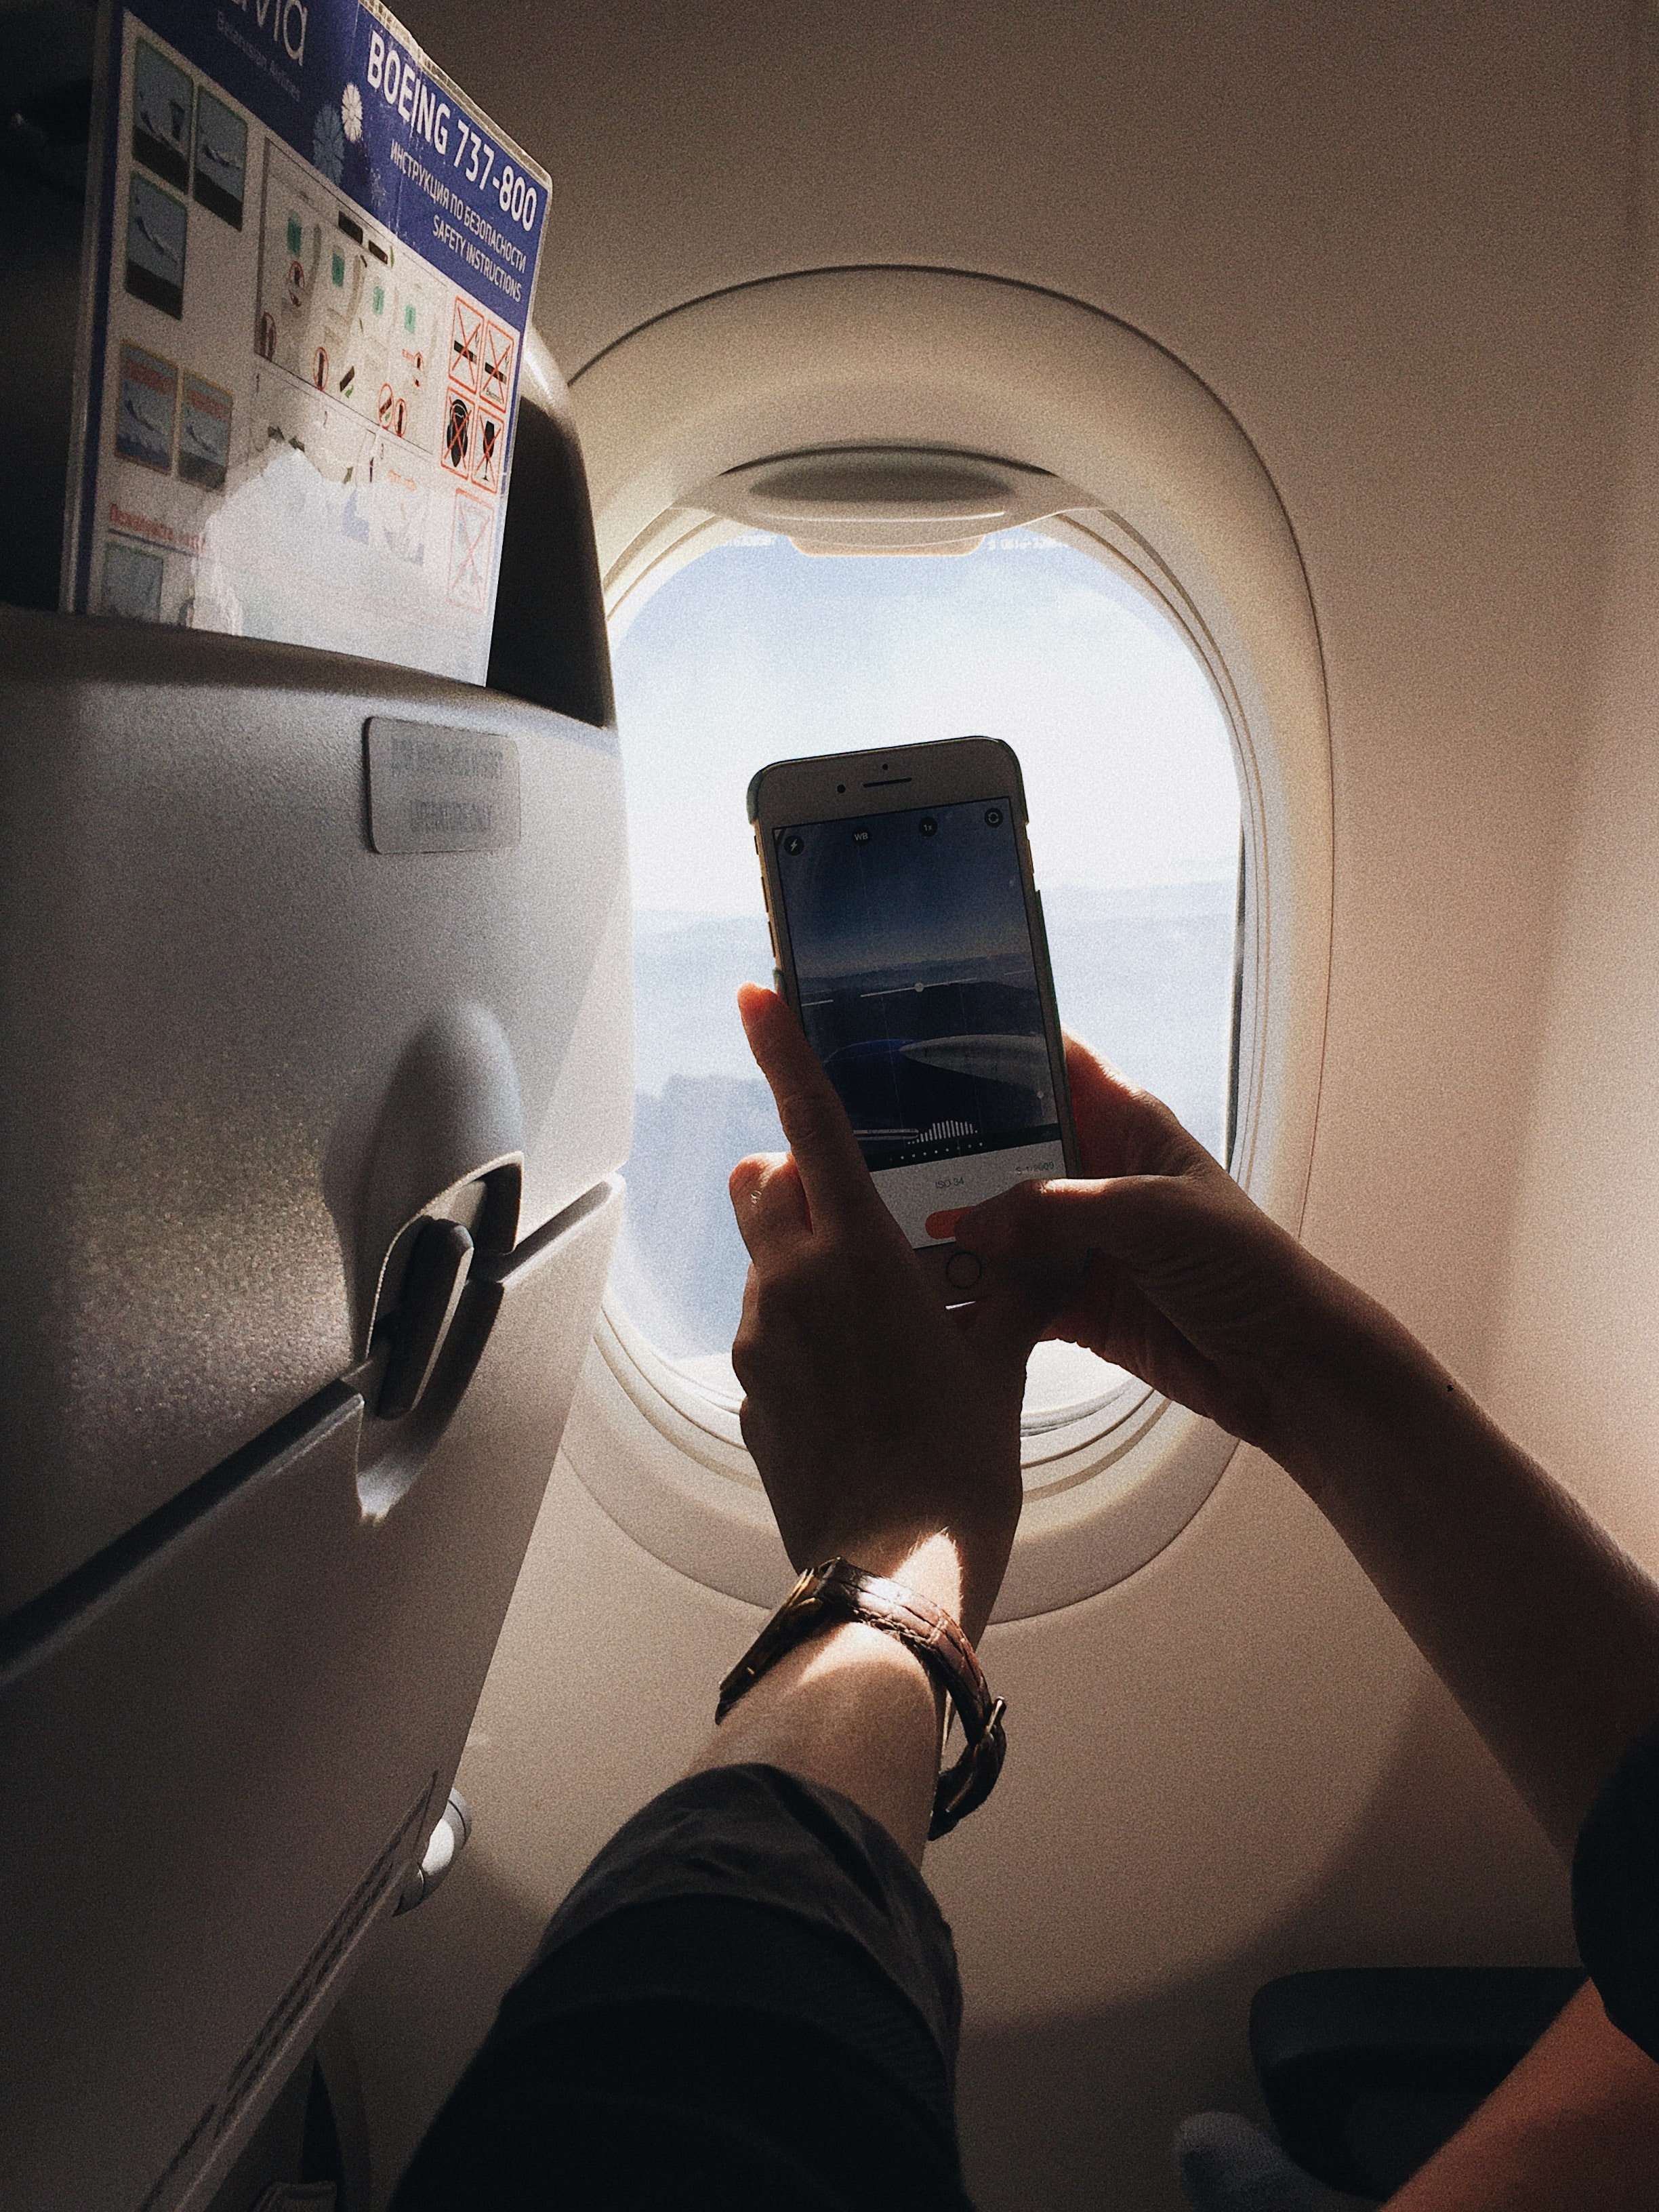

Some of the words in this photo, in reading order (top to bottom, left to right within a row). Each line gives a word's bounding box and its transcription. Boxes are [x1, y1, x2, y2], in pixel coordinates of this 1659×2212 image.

[367, 30, 451, 155] BOEING
[453, 119, 537, 232] 737-800
[390, 138, 450, 210] ИНСТРУКЦИЯ
[450, 193, 464, 221] ПО
[464, 205, 527, 274] БЕЗОПАСНОСТИ
[432, 214, 468, 258] SAFETY
[466, 240, 522, 302] INSTRUCTIONS
[854, 832, 868, 841] WB
[935, 1179, 951, 1189] ISO
[953, 1176, 964, 1186] 34
